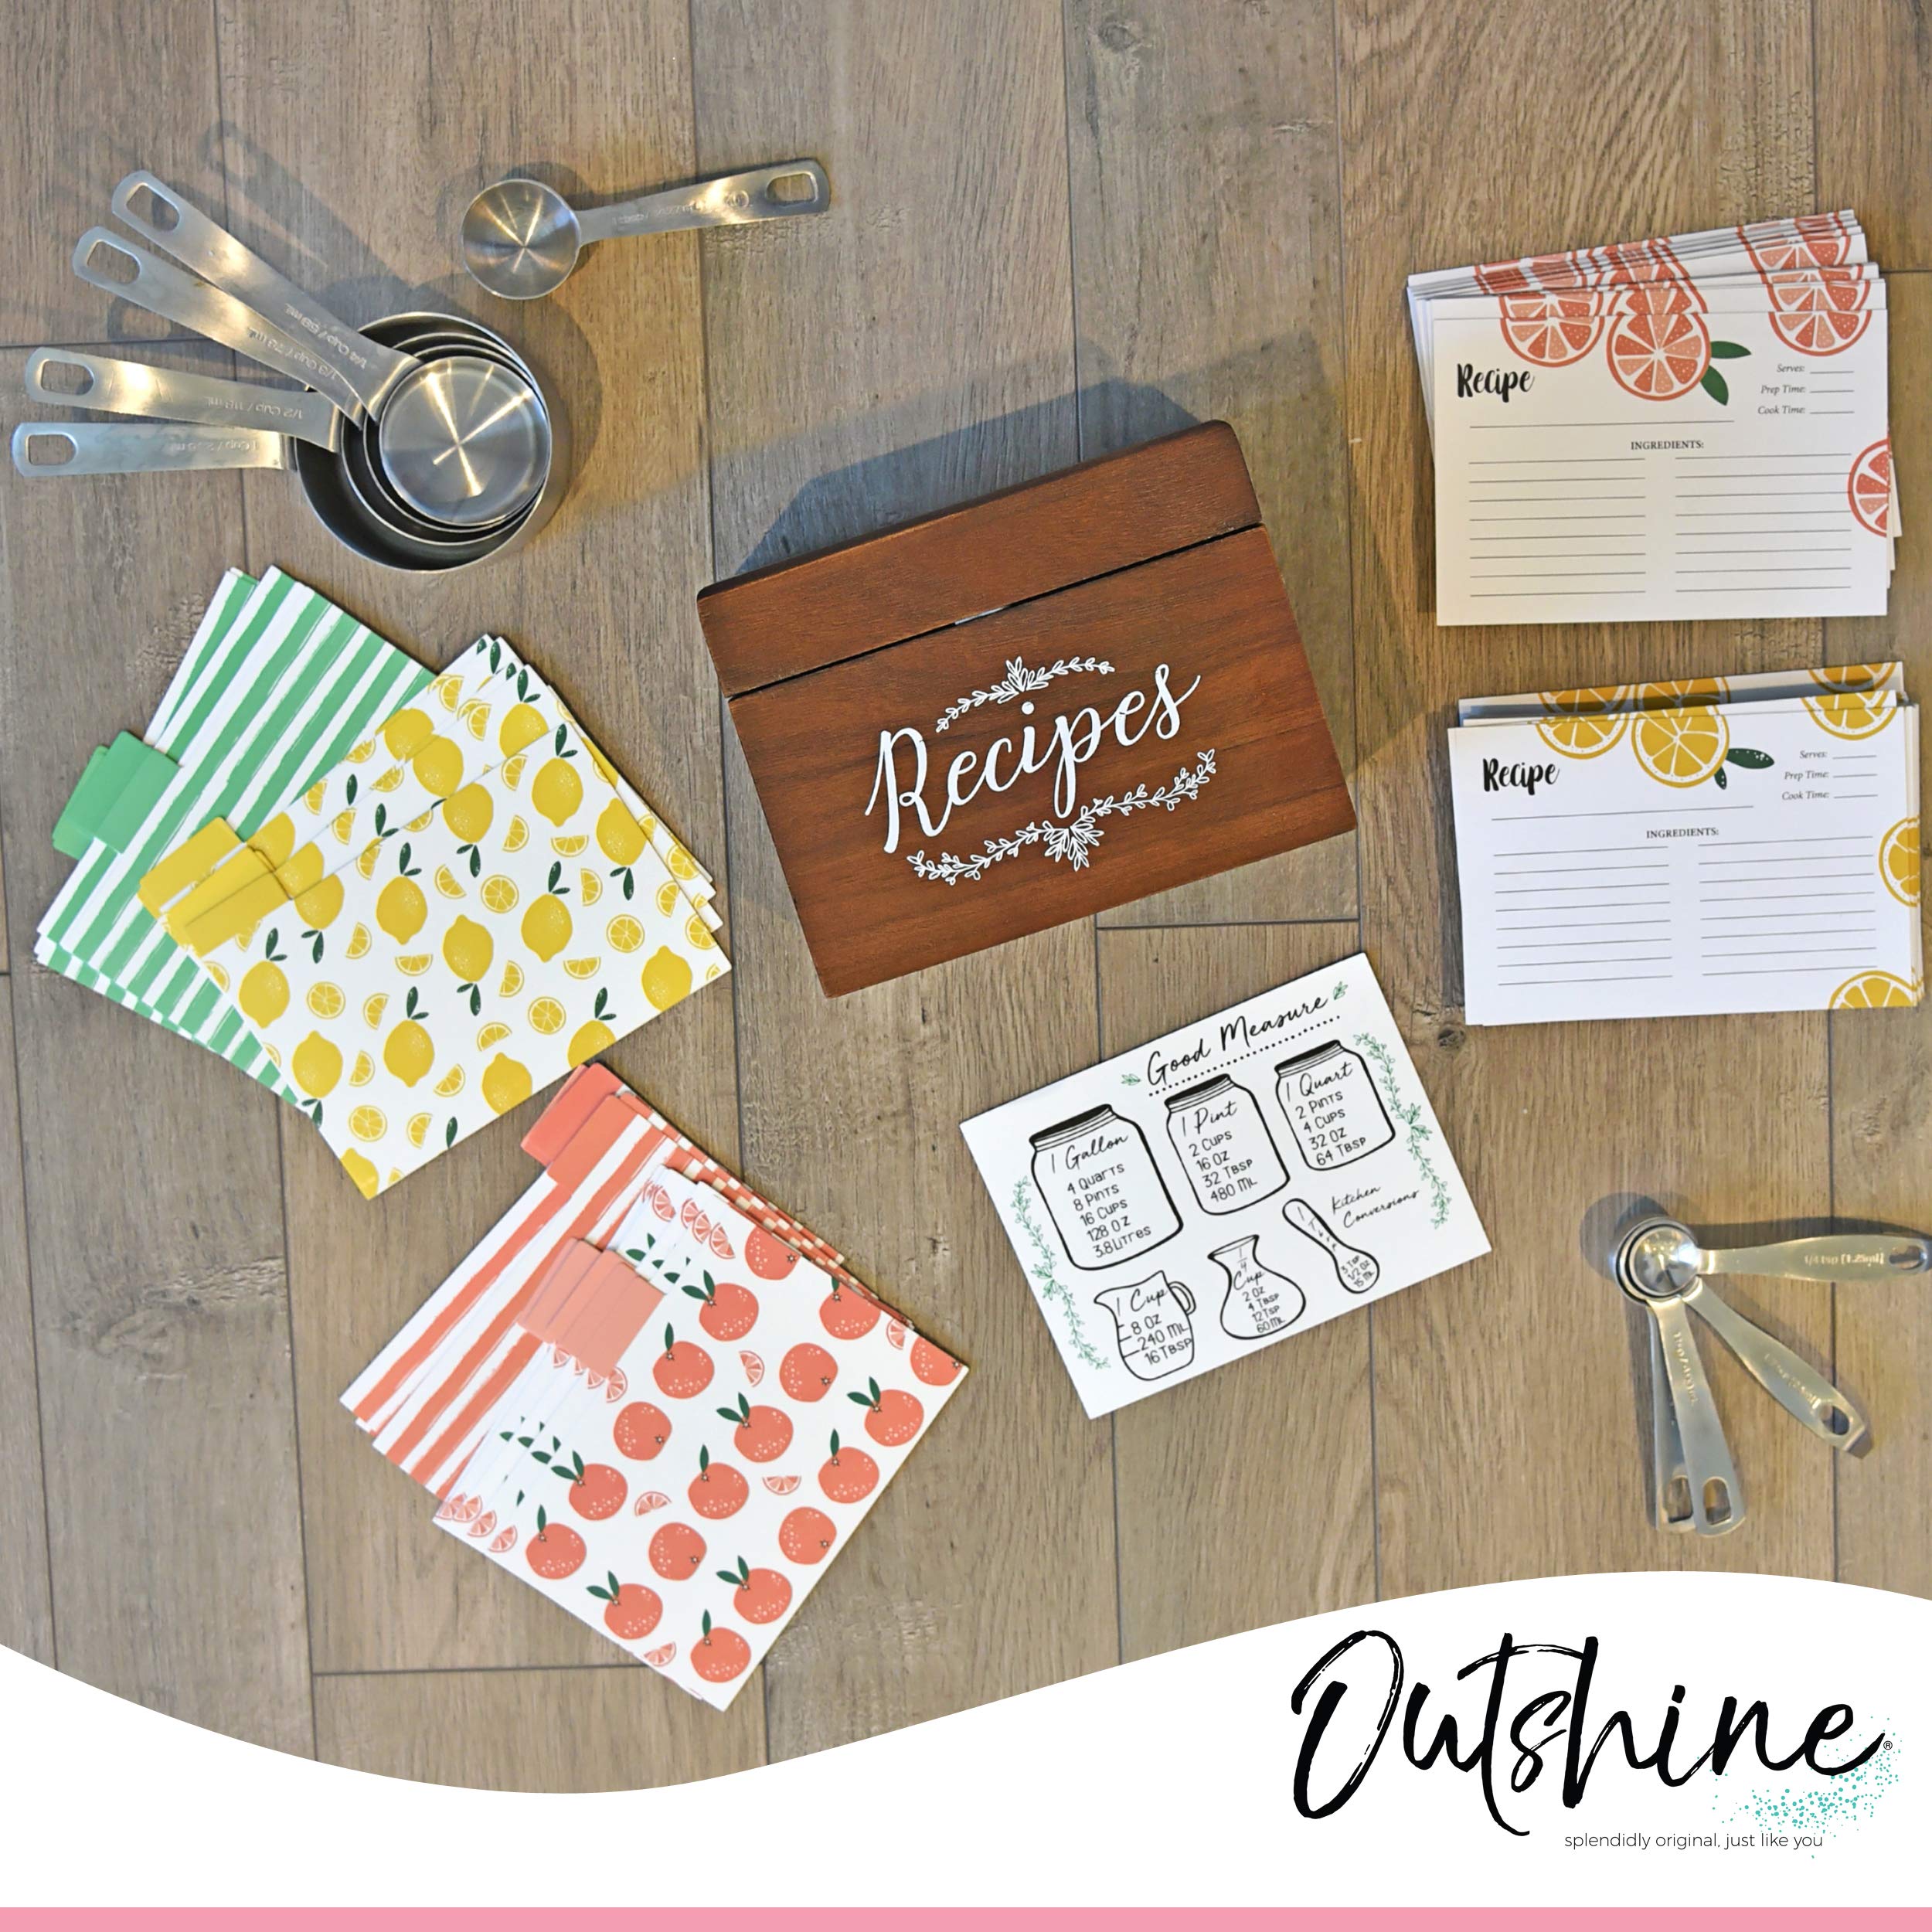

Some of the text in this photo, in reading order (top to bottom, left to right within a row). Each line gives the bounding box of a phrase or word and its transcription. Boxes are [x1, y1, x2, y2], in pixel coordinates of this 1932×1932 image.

[1777, 363, 1804, 372] Serves:
[1457, 363, 1535, 403] Recipe
[1760, 385, 1806, 396] Prep Time:
[1757, 405, 1806, 415] Cook Time:
[1631, 440, 1704, 450] INGREDIENTS:
[865, 663, 1201, 854] Recipes
[1799, 750, 1828, 759] Serves:
[1482, 758, 1560, 795] Recipe
[1784, 770, 1829, 781] Prep Time:
[1781, 791, 1829, 801] Cook Time:
[1646, 827, 1719, 838] INGREDIENTS:
[1147, 997, 1328, 1086] Good Measure
[1300, 1062, 1353, 1097] Quart
[1194, 1100, 1237, 1134] Pint
[1295, 1106, 1306, 1119] 2
[1304, 1121, 1312, 1133] 4
[1308, 1134, 1328, 1150] 32
[1066, 1134, 1129, 1171] Gallon
[1189, 1144, 1200, 1157] 2
[1316, 1150, 1334, 1165] 64
[1196, 1158, 1211, 1172] 16
[1202, 1171, 1222, 1188] 32
[1066, 1182, 1077, 1195] 4
[1210, 1183, 1236, 1202] 480
[1073, 1199, 1083, 1212] 8
[1332, 1186, 1381, 1215] Kitchen
[1343, 1189, 1420, 1228] Conversions
[1080, 1212, 1095, 1226] 16
[1087, 1224, 1110, 1242] 128
[1233, 1270, 1265, 1291] Cup
[1131, 1288, 1168, 1311] Cup
[1242, 1291, 1251, 1302] 2
[1131, 1321, 1141, 1335] 8
[1138, 1330, 1165, 1351] 240
